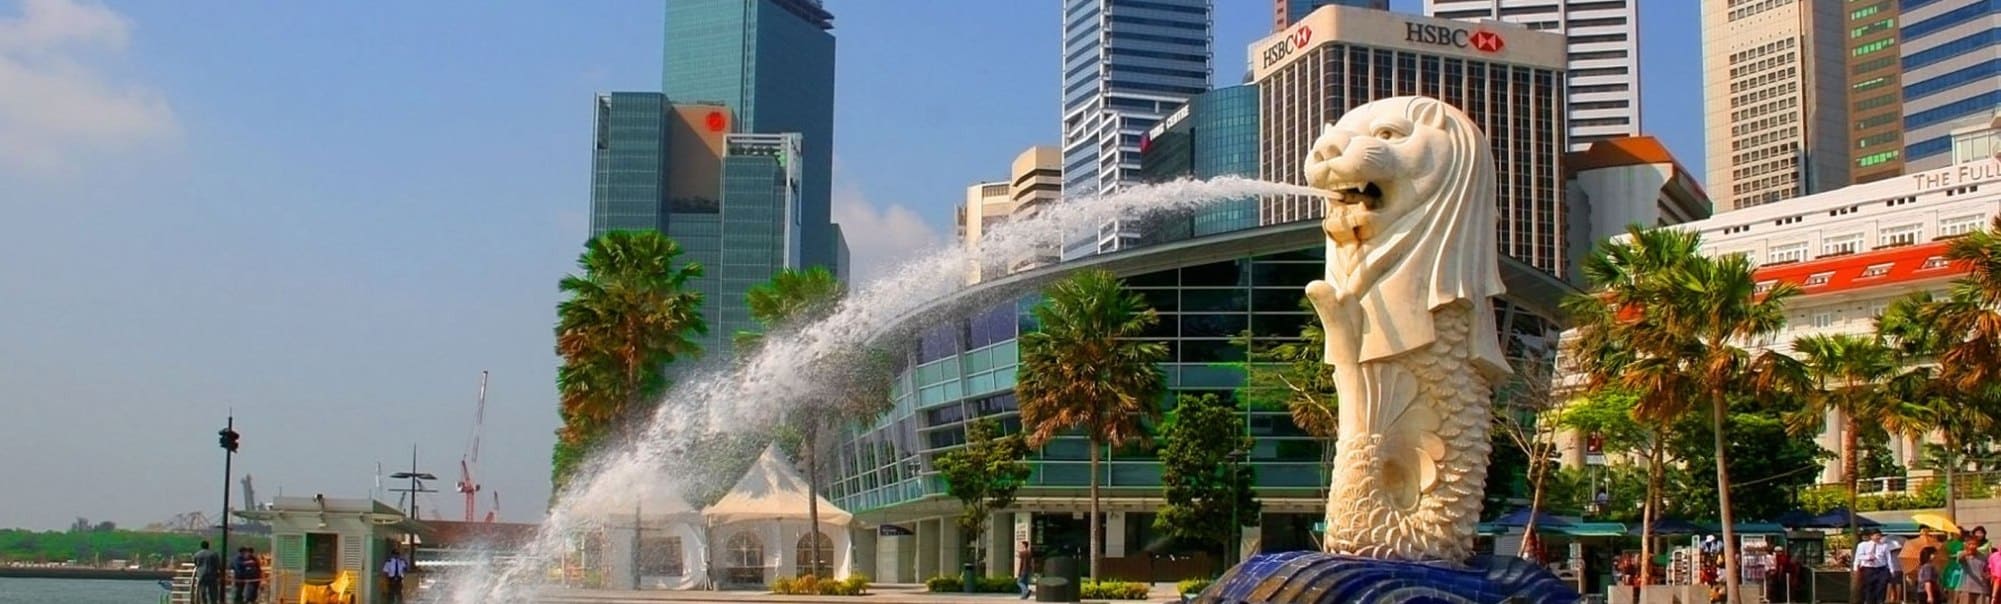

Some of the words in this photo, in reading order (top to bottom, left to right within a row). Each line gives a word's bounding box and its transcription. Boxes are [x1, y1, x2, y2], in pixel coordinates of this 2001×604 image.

[1405, 22, 1469, 48] HSBC
[1263, 34, 1295, 69] HSBC
[1913, 172, 1950, 190] THE
[1958, 163, 2001, 183] FULL
